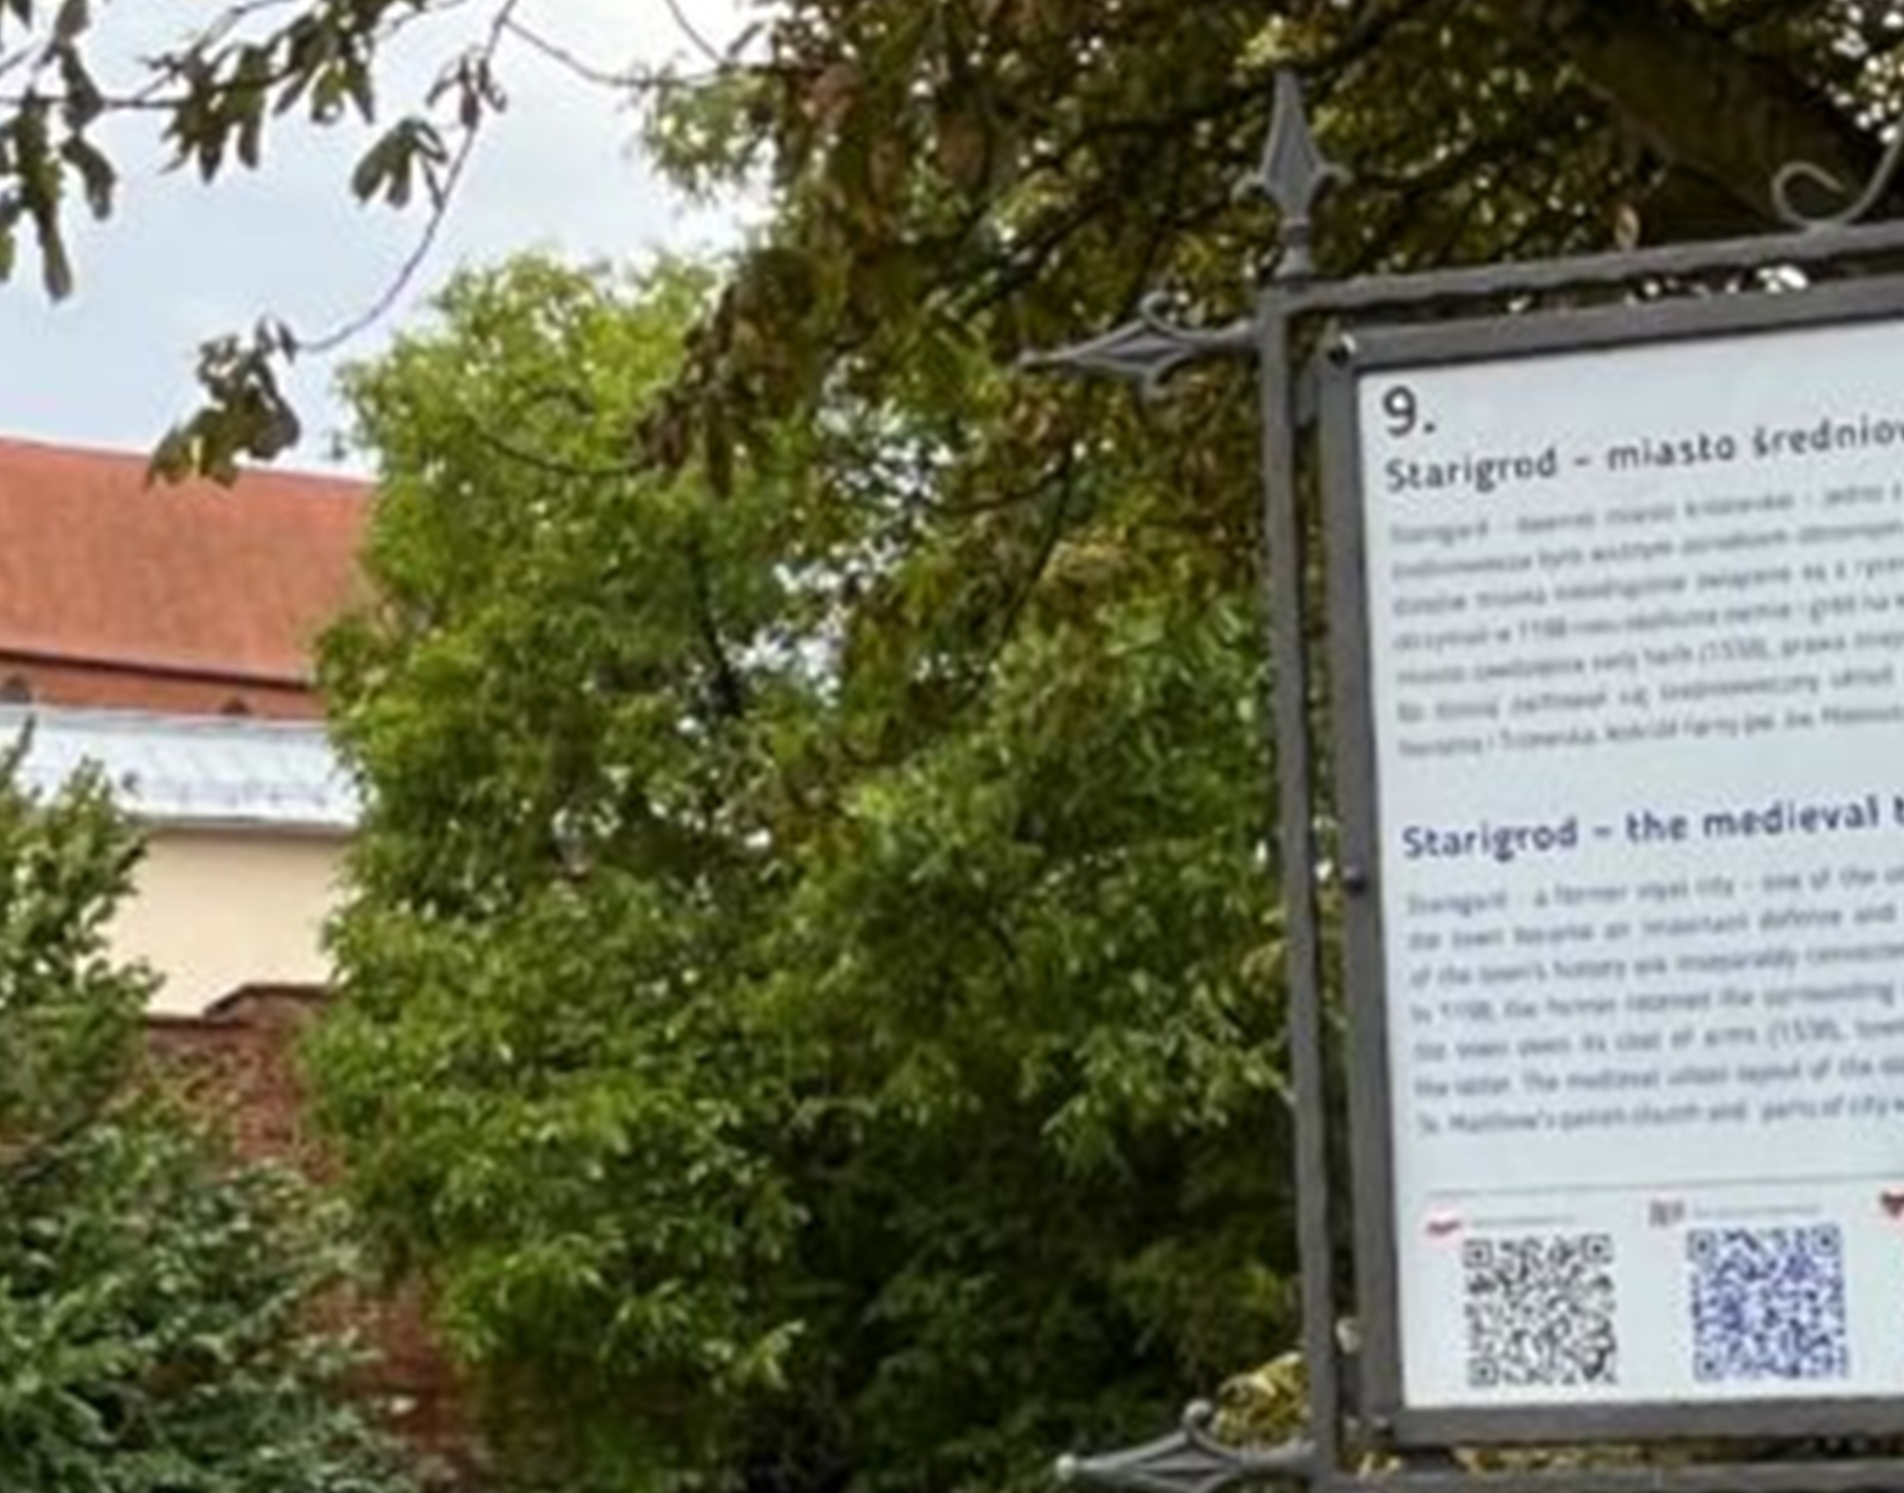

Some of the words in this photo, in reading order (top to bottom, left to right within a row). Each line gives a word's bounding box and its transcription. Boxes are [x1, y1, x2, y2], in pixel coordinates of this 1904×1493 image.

[1380, 381, 1436, 439] 9.
[1383, 445, 1559, 496] Starigrod
[1605, 433, 1737, 473] miasto
[1400, 813, 1579, 862] Starigrod
[1624, 807, 1689, 844] the
[1701, 791, 1881, 839] medieval
